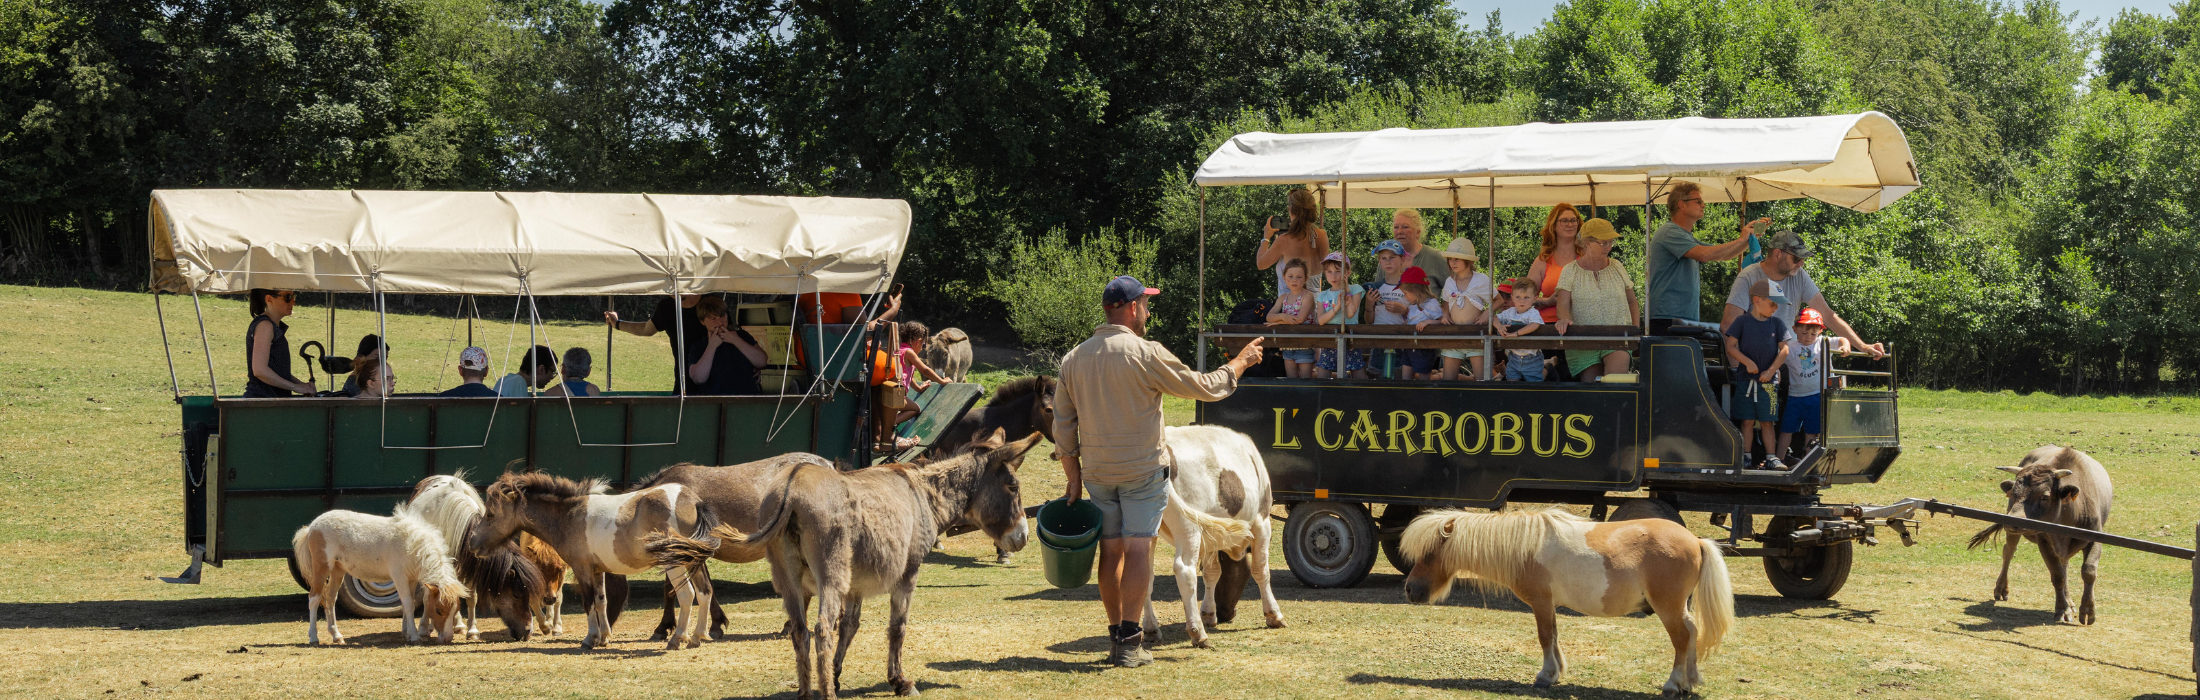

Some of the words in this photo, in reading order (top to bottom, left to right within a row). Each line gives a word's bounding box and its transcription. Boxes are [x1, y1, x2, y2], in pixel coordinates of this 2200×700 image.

[1800, 369, 1818, 378] BLUEY
[1272, 407, 1301, 450] L'
[1314, 408, 1595, 458] CARROBUS
